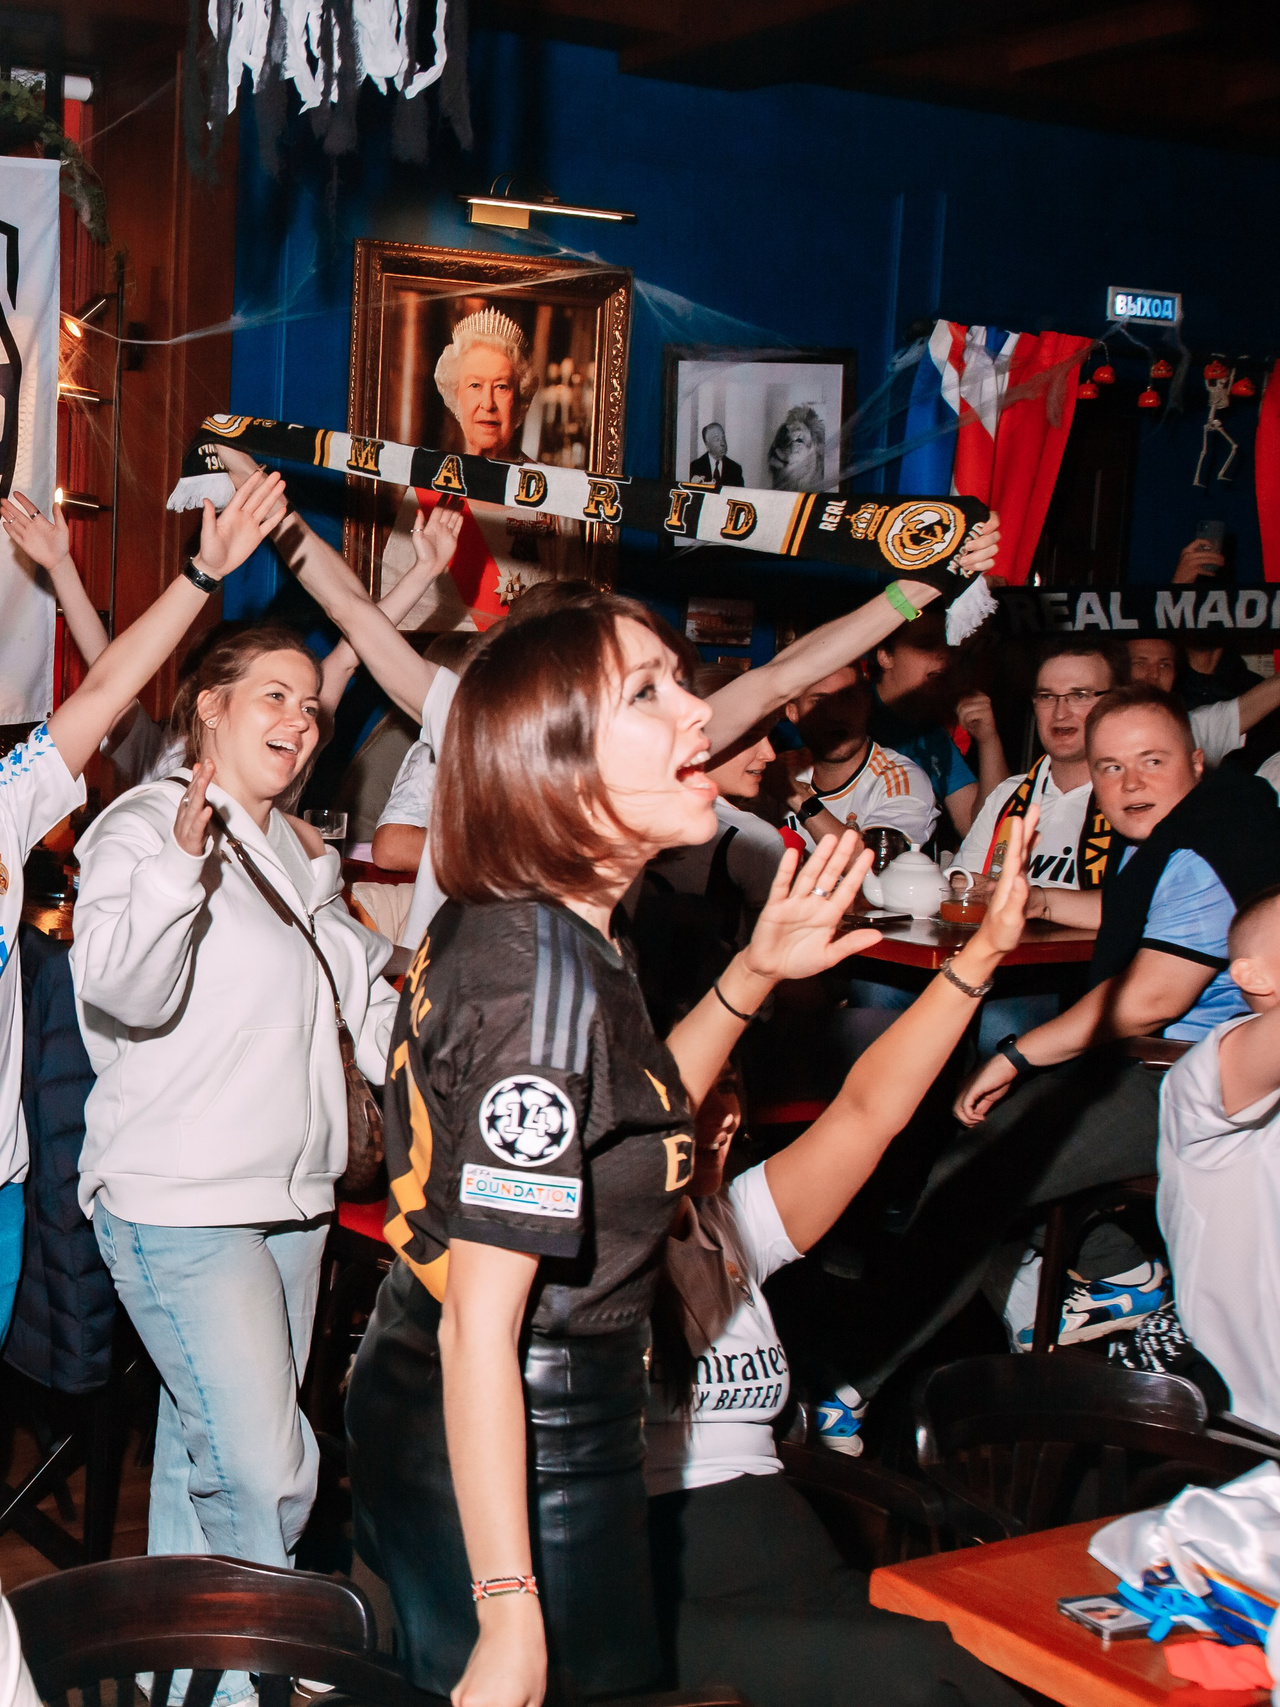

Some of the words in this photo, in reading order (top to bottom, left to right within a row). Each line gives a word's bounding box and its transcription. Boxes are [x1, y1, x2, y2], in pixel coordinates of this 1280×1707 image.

[1115, 293, 1173, 320] ВЫХОД
[346, 435, 758, 542] MADRID
[819, 499, 848, 532] REAL
[504, 1102, 550, 1138] 14
[465, 1178, 577, 1203] FOUNDATION
[697, 1343, 788, 1385] mirates
[711, 1383, 783, 1411] BETTER
